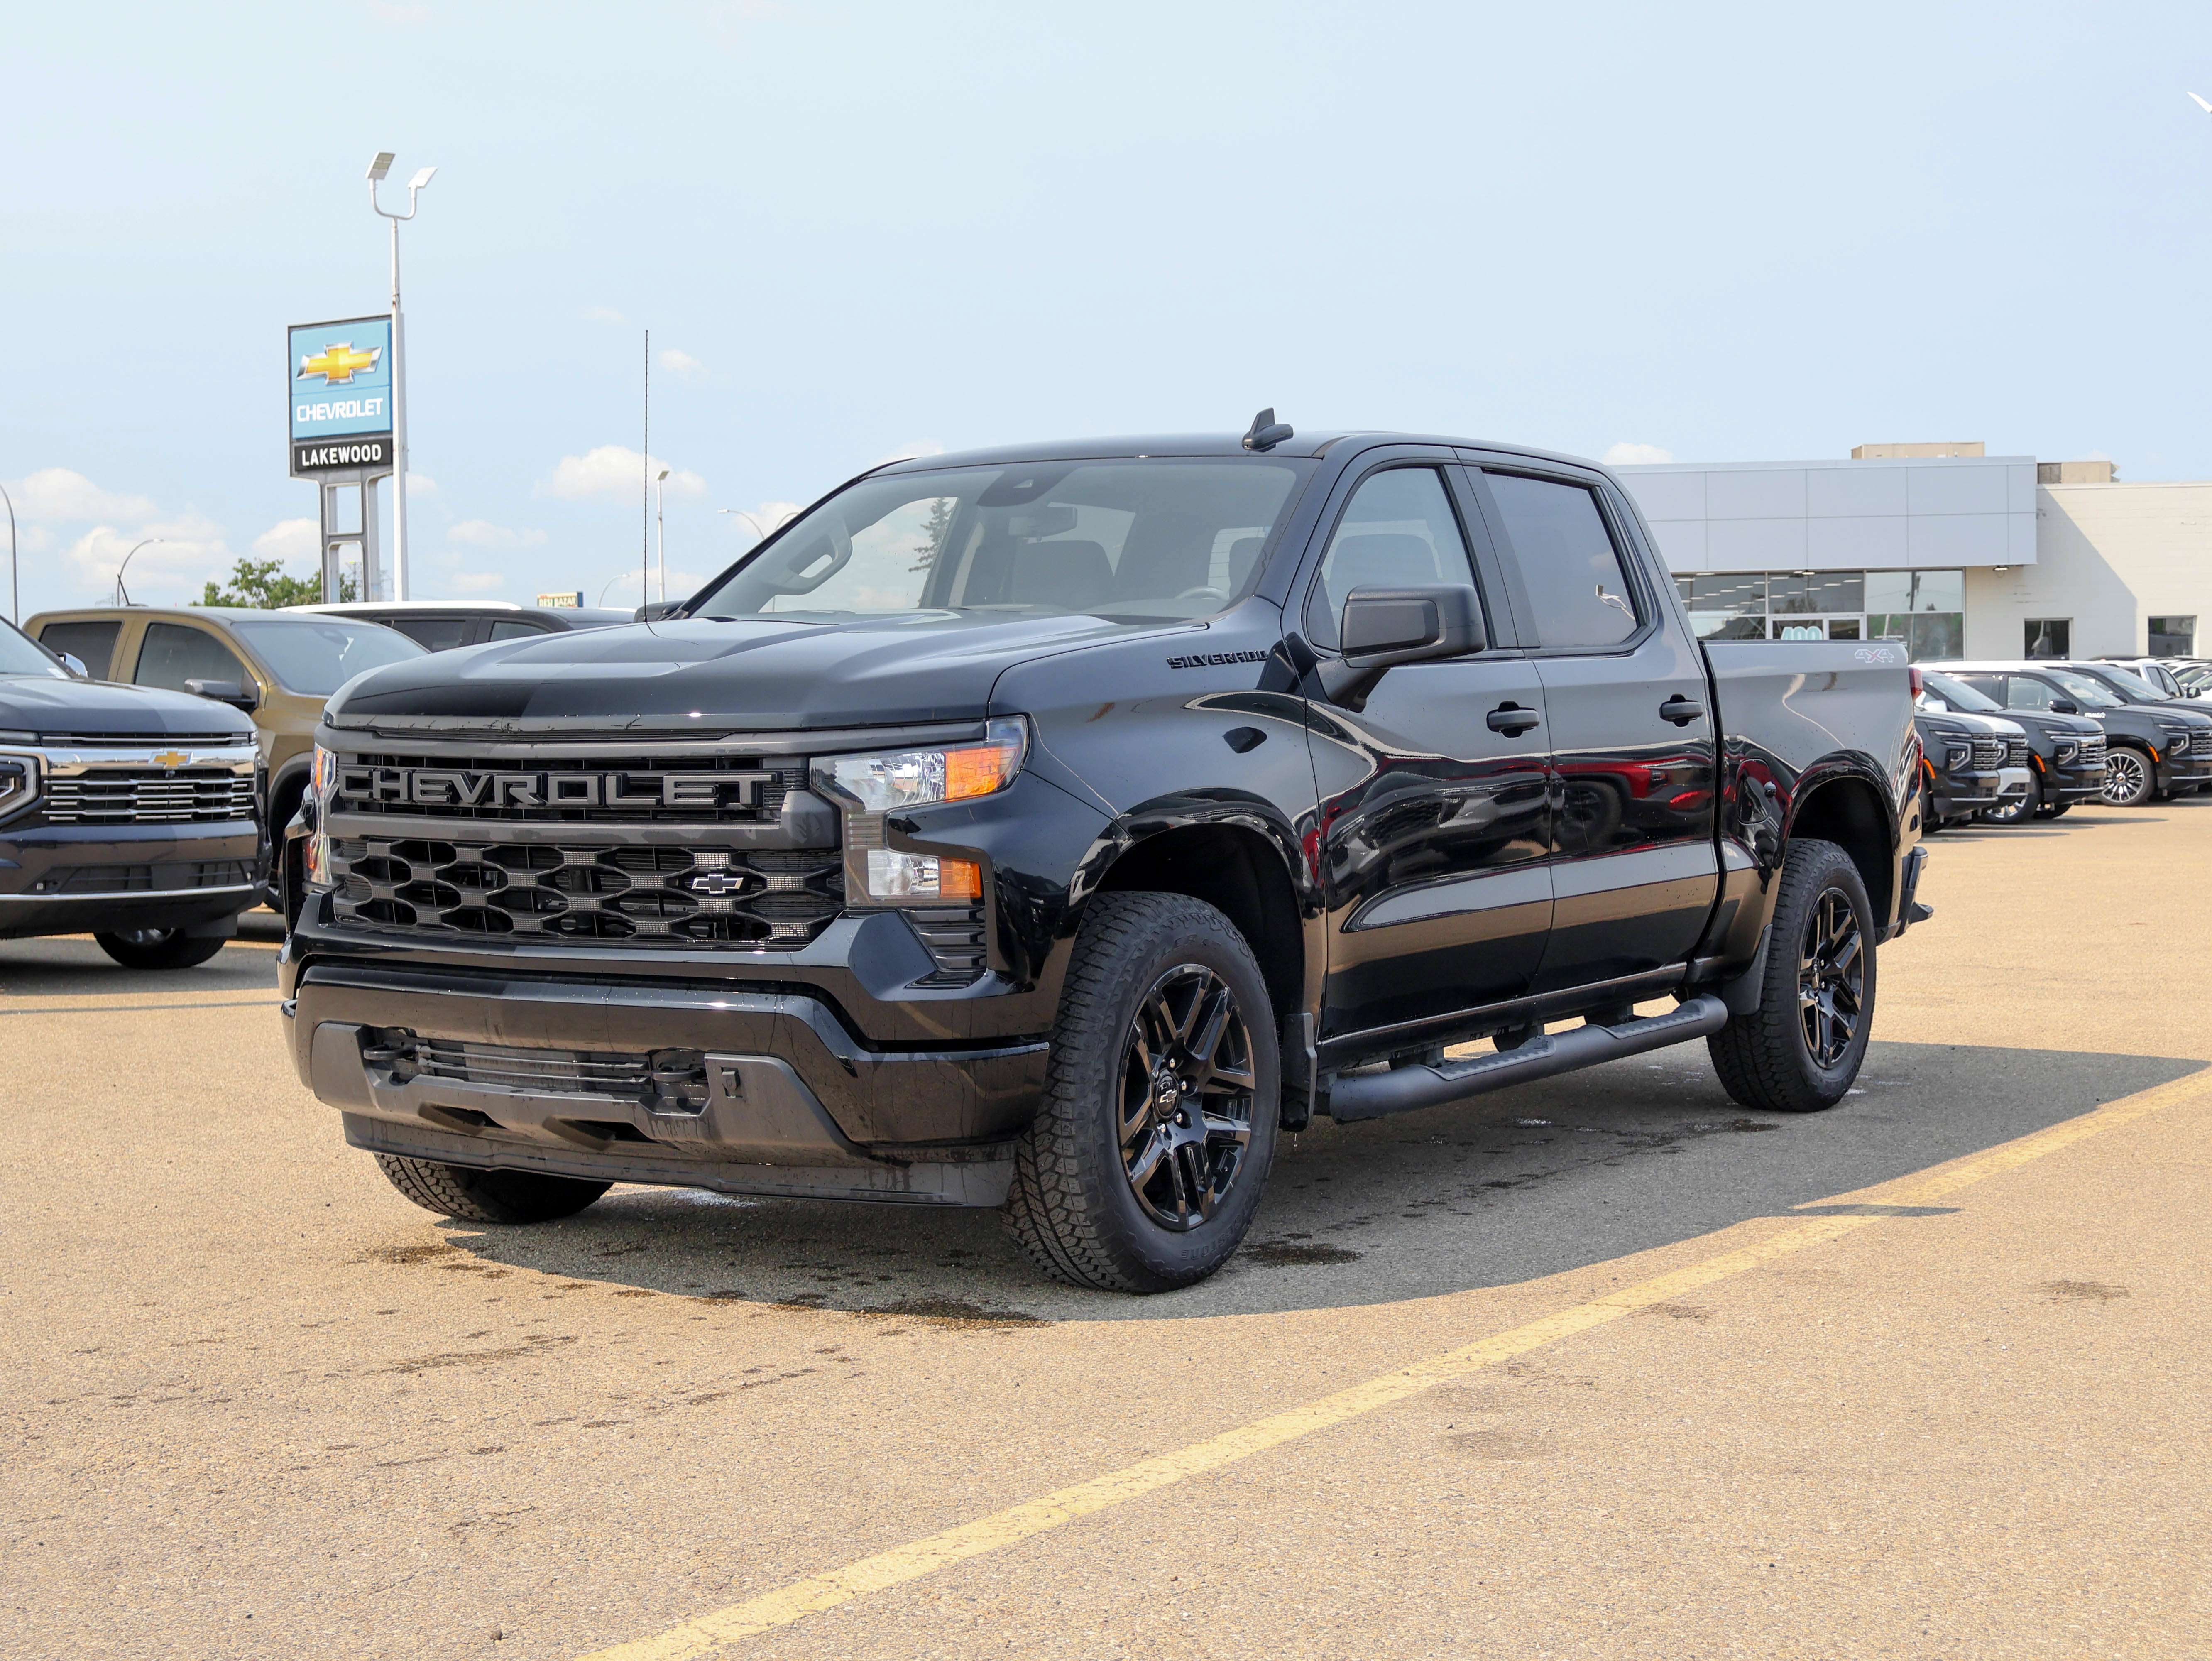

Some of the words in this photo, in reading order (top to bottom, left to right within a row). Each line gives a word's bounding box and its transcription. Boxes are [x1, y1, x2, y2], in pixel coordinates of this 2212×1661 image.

[296, 397, 383, 422] CHEVROLET
[302, 444, 382, 466] LAKEWOOD
[1167, 650, 1268, 669] SILVERADO
[338, 767, 784, 808] CHEVROLET
